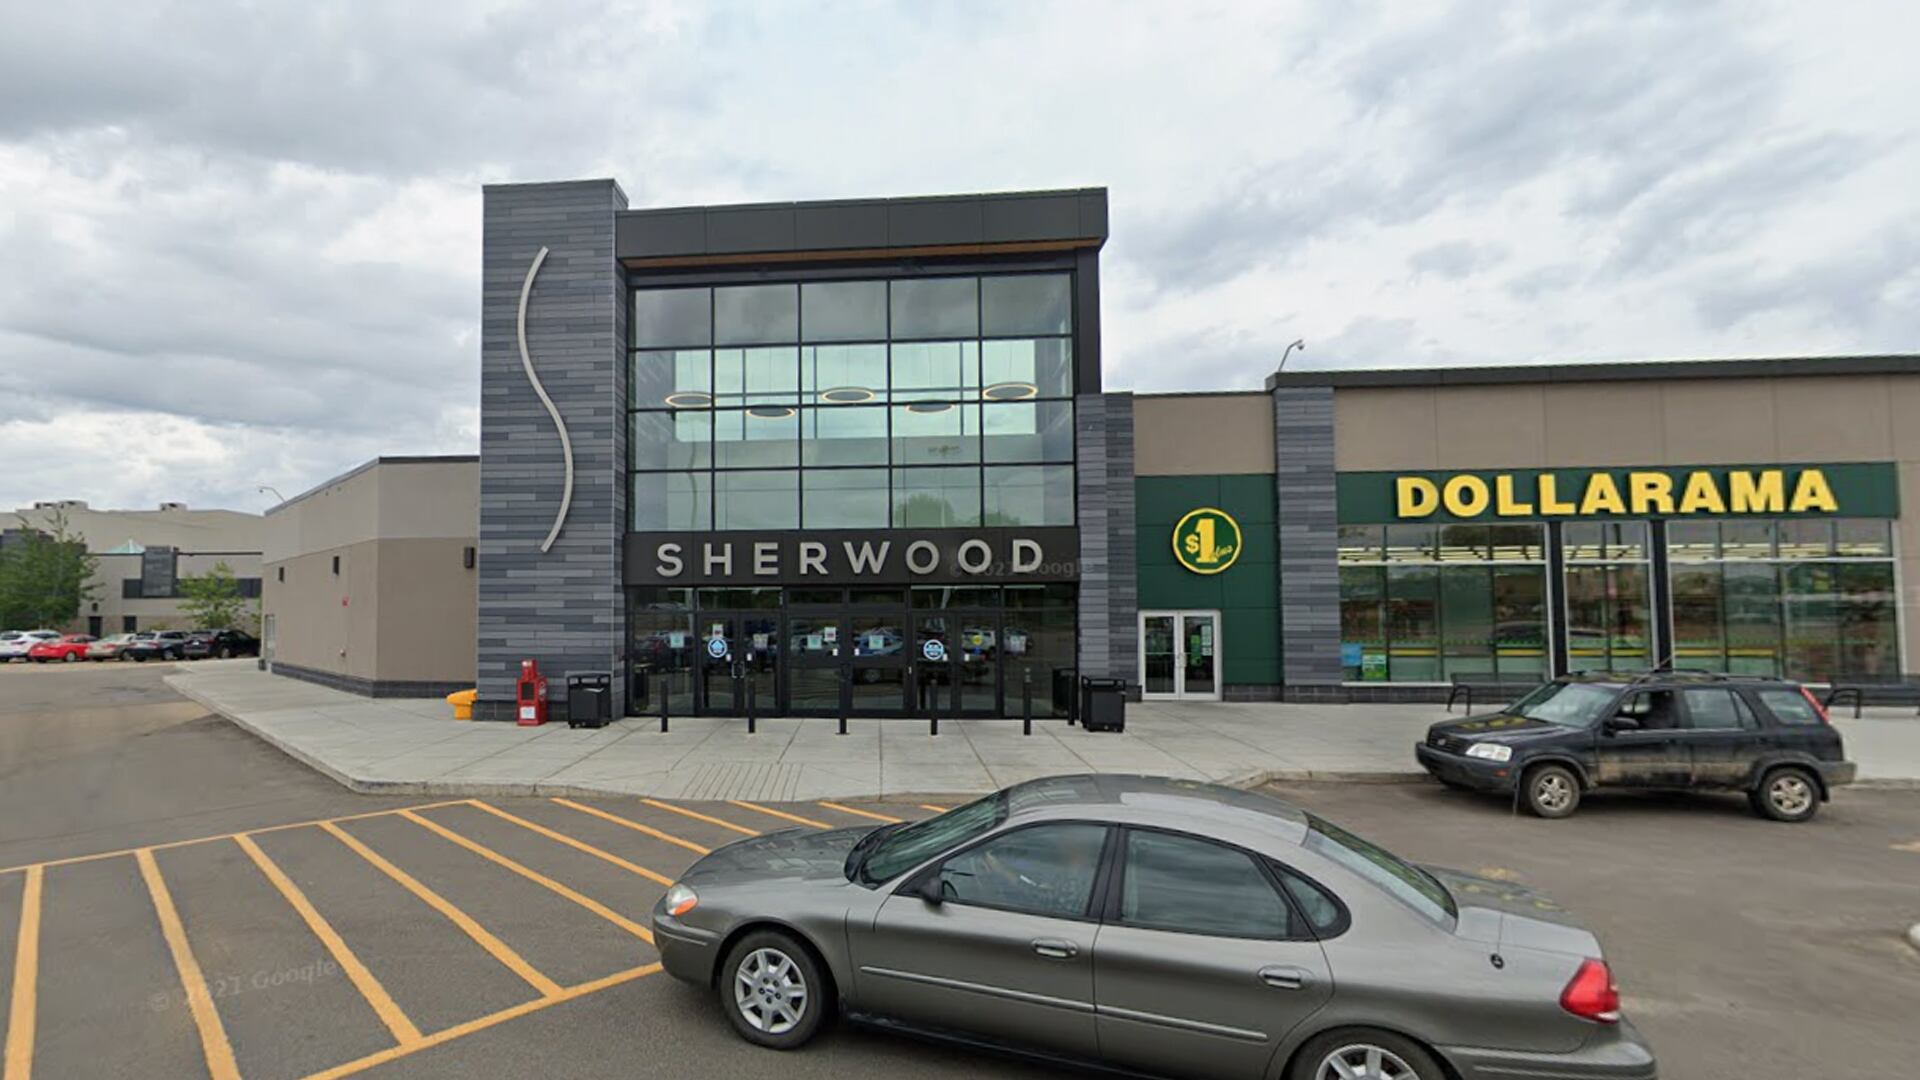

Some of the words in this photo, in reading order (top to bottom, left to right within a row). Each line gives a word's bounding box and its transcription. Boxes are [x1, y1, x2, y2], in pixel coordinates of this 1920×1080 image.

[1396, 467, 1838, 518] DOLLARAMA
[655, 538, 1044, 577] SHERWOOD
[1185, 518, 1218, 563] $1
